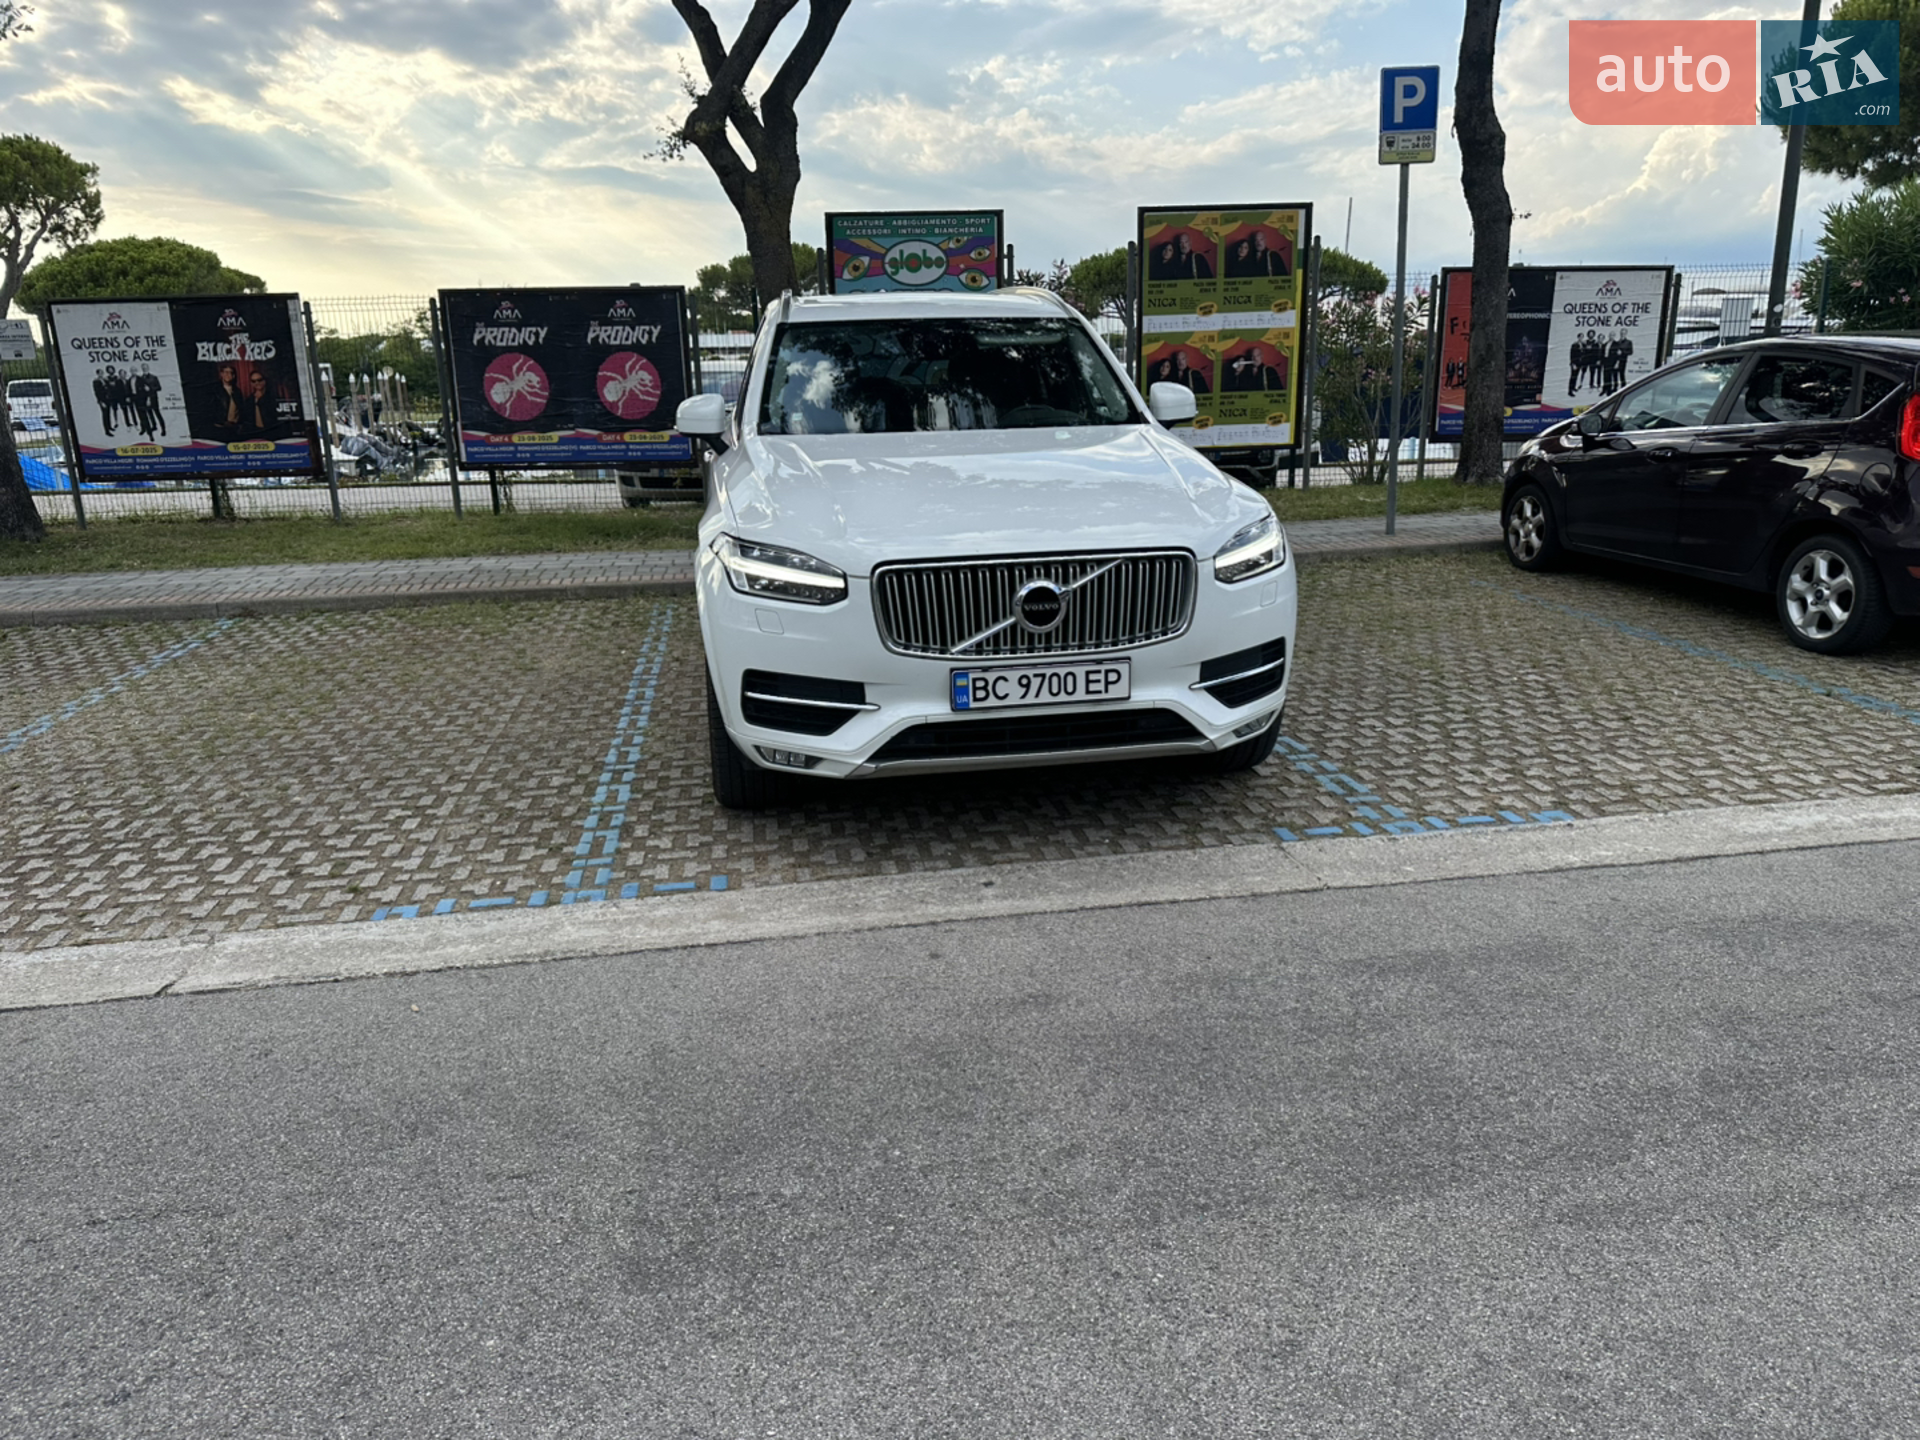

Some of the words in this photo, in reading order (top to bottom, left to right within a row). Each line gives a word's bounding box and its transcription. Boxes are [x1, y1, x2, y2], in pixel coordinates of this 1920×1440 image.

[1393, 75, 1426, 123] P
[892, 218, 957, 226] ABBIGLIAMENTO
[934, 226, 983, 234] BIANCHERIA
[887, 249, 945, 276] globo
[1595, 287, 1622, 296] AMA
[493, 309, 522, 319] AMA
[607, 308, 636, 318] AMA
[1563, 302, 1608, 314] QUEENS
[1611, 302, 1629, 314] OF
[1630, 302, 1652, 314] THE
[102, 320, 130, 330] AMA
[217, 316, 246, 326] AMA
[1574, 315, 1612, 327] STONE
[1614, 315, 1641, 327] AGE
[229, 332, 250, 345] THE
[472, 327, 548, 346] PRODIGY
[587, 325, 662, 345] PRODIGY
[70, 337, 120, 350] QUEENS
[124, 336, 141, 348] OF
[144, 335, 167, 348] THE
[88, 350, 128, 363] STONE
[133, 349, 159, 361] AGE
[196, 342, 242, 362] BLACK
[245, 340, 276, 361] KEYS
[276, 402, 298, 412] JET
[1024, 602, 1059, 611] VOLVO
[972, 676, 1009, 702] BC
[1018, 671, 1077, 700] 9700
[1085, 668, 1122, 696] EP
[956, 695, 968, 703] UA
